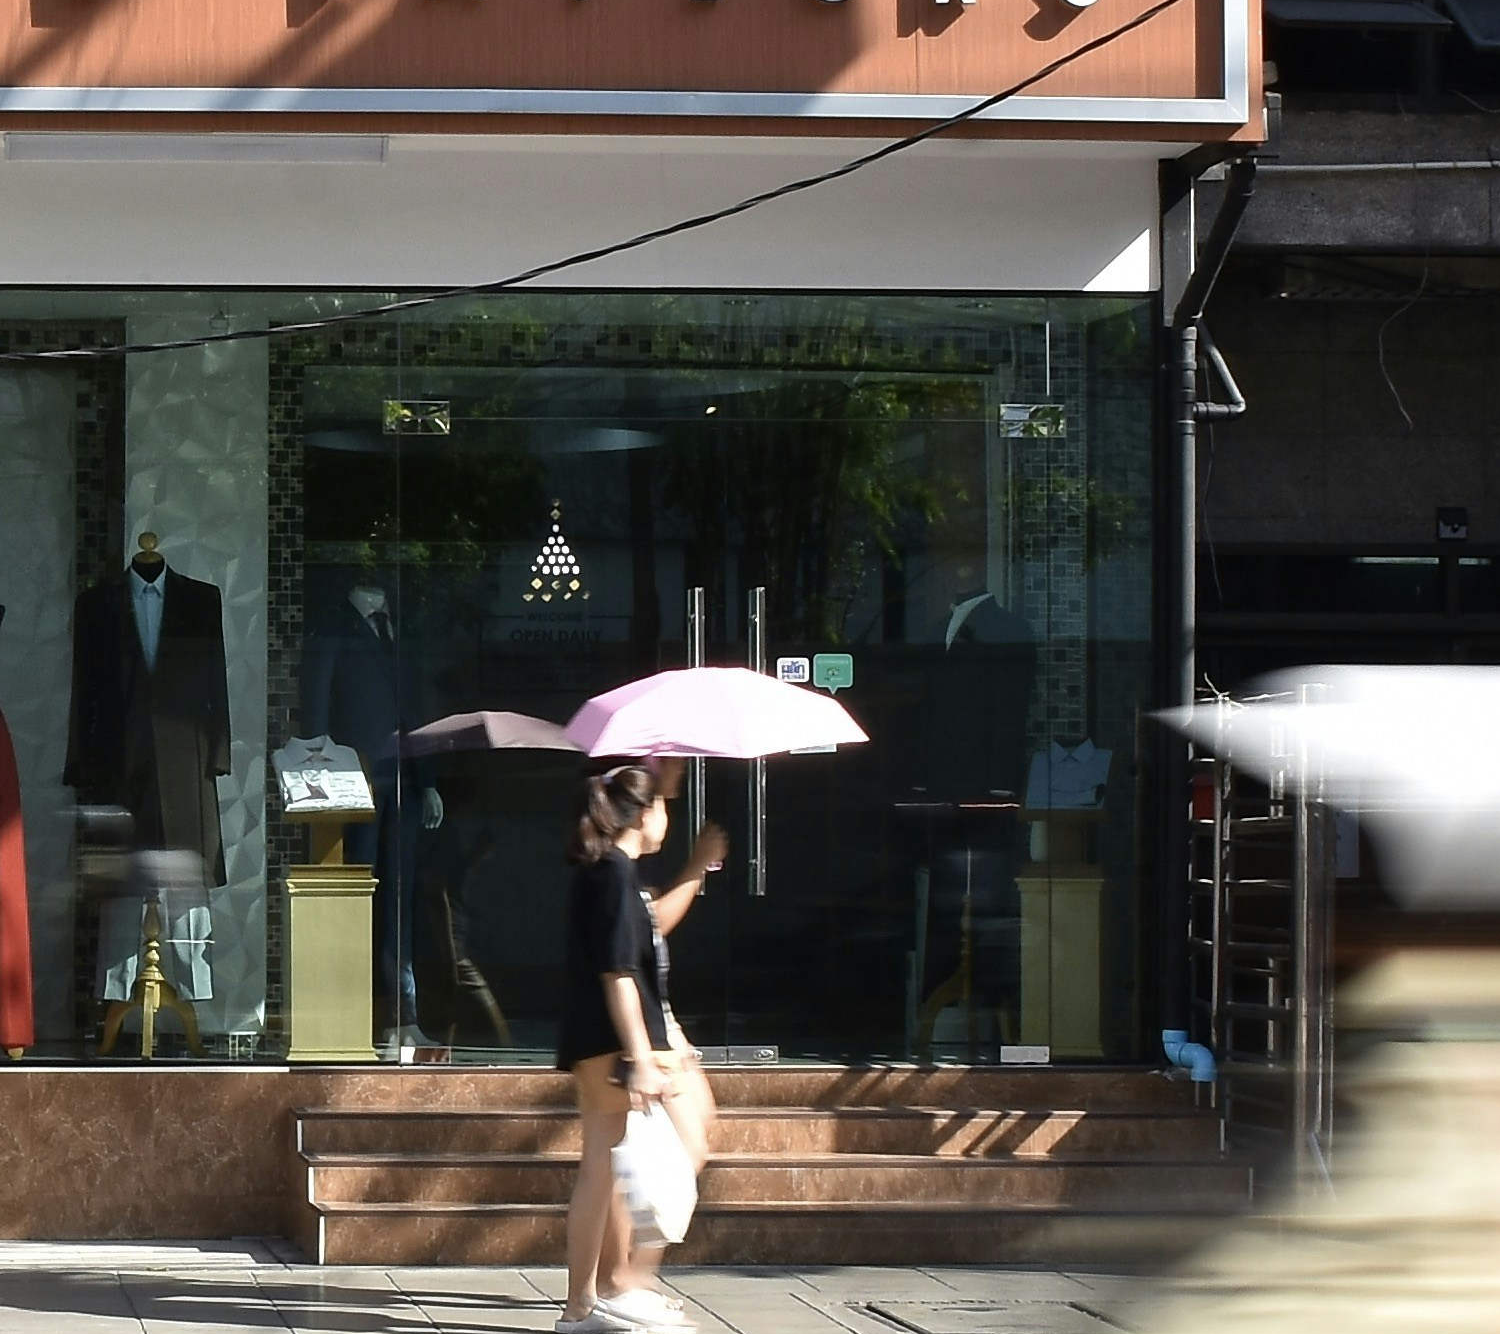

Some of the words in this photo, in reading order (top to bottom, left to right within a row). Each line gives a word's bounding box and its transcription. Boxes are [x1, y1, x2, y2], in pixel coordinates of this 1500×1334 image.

[526, 612, 584, 622] WELCOME
[510, 629, 553, 643] OPEN
[557, 629, 603, 643] DAILY
